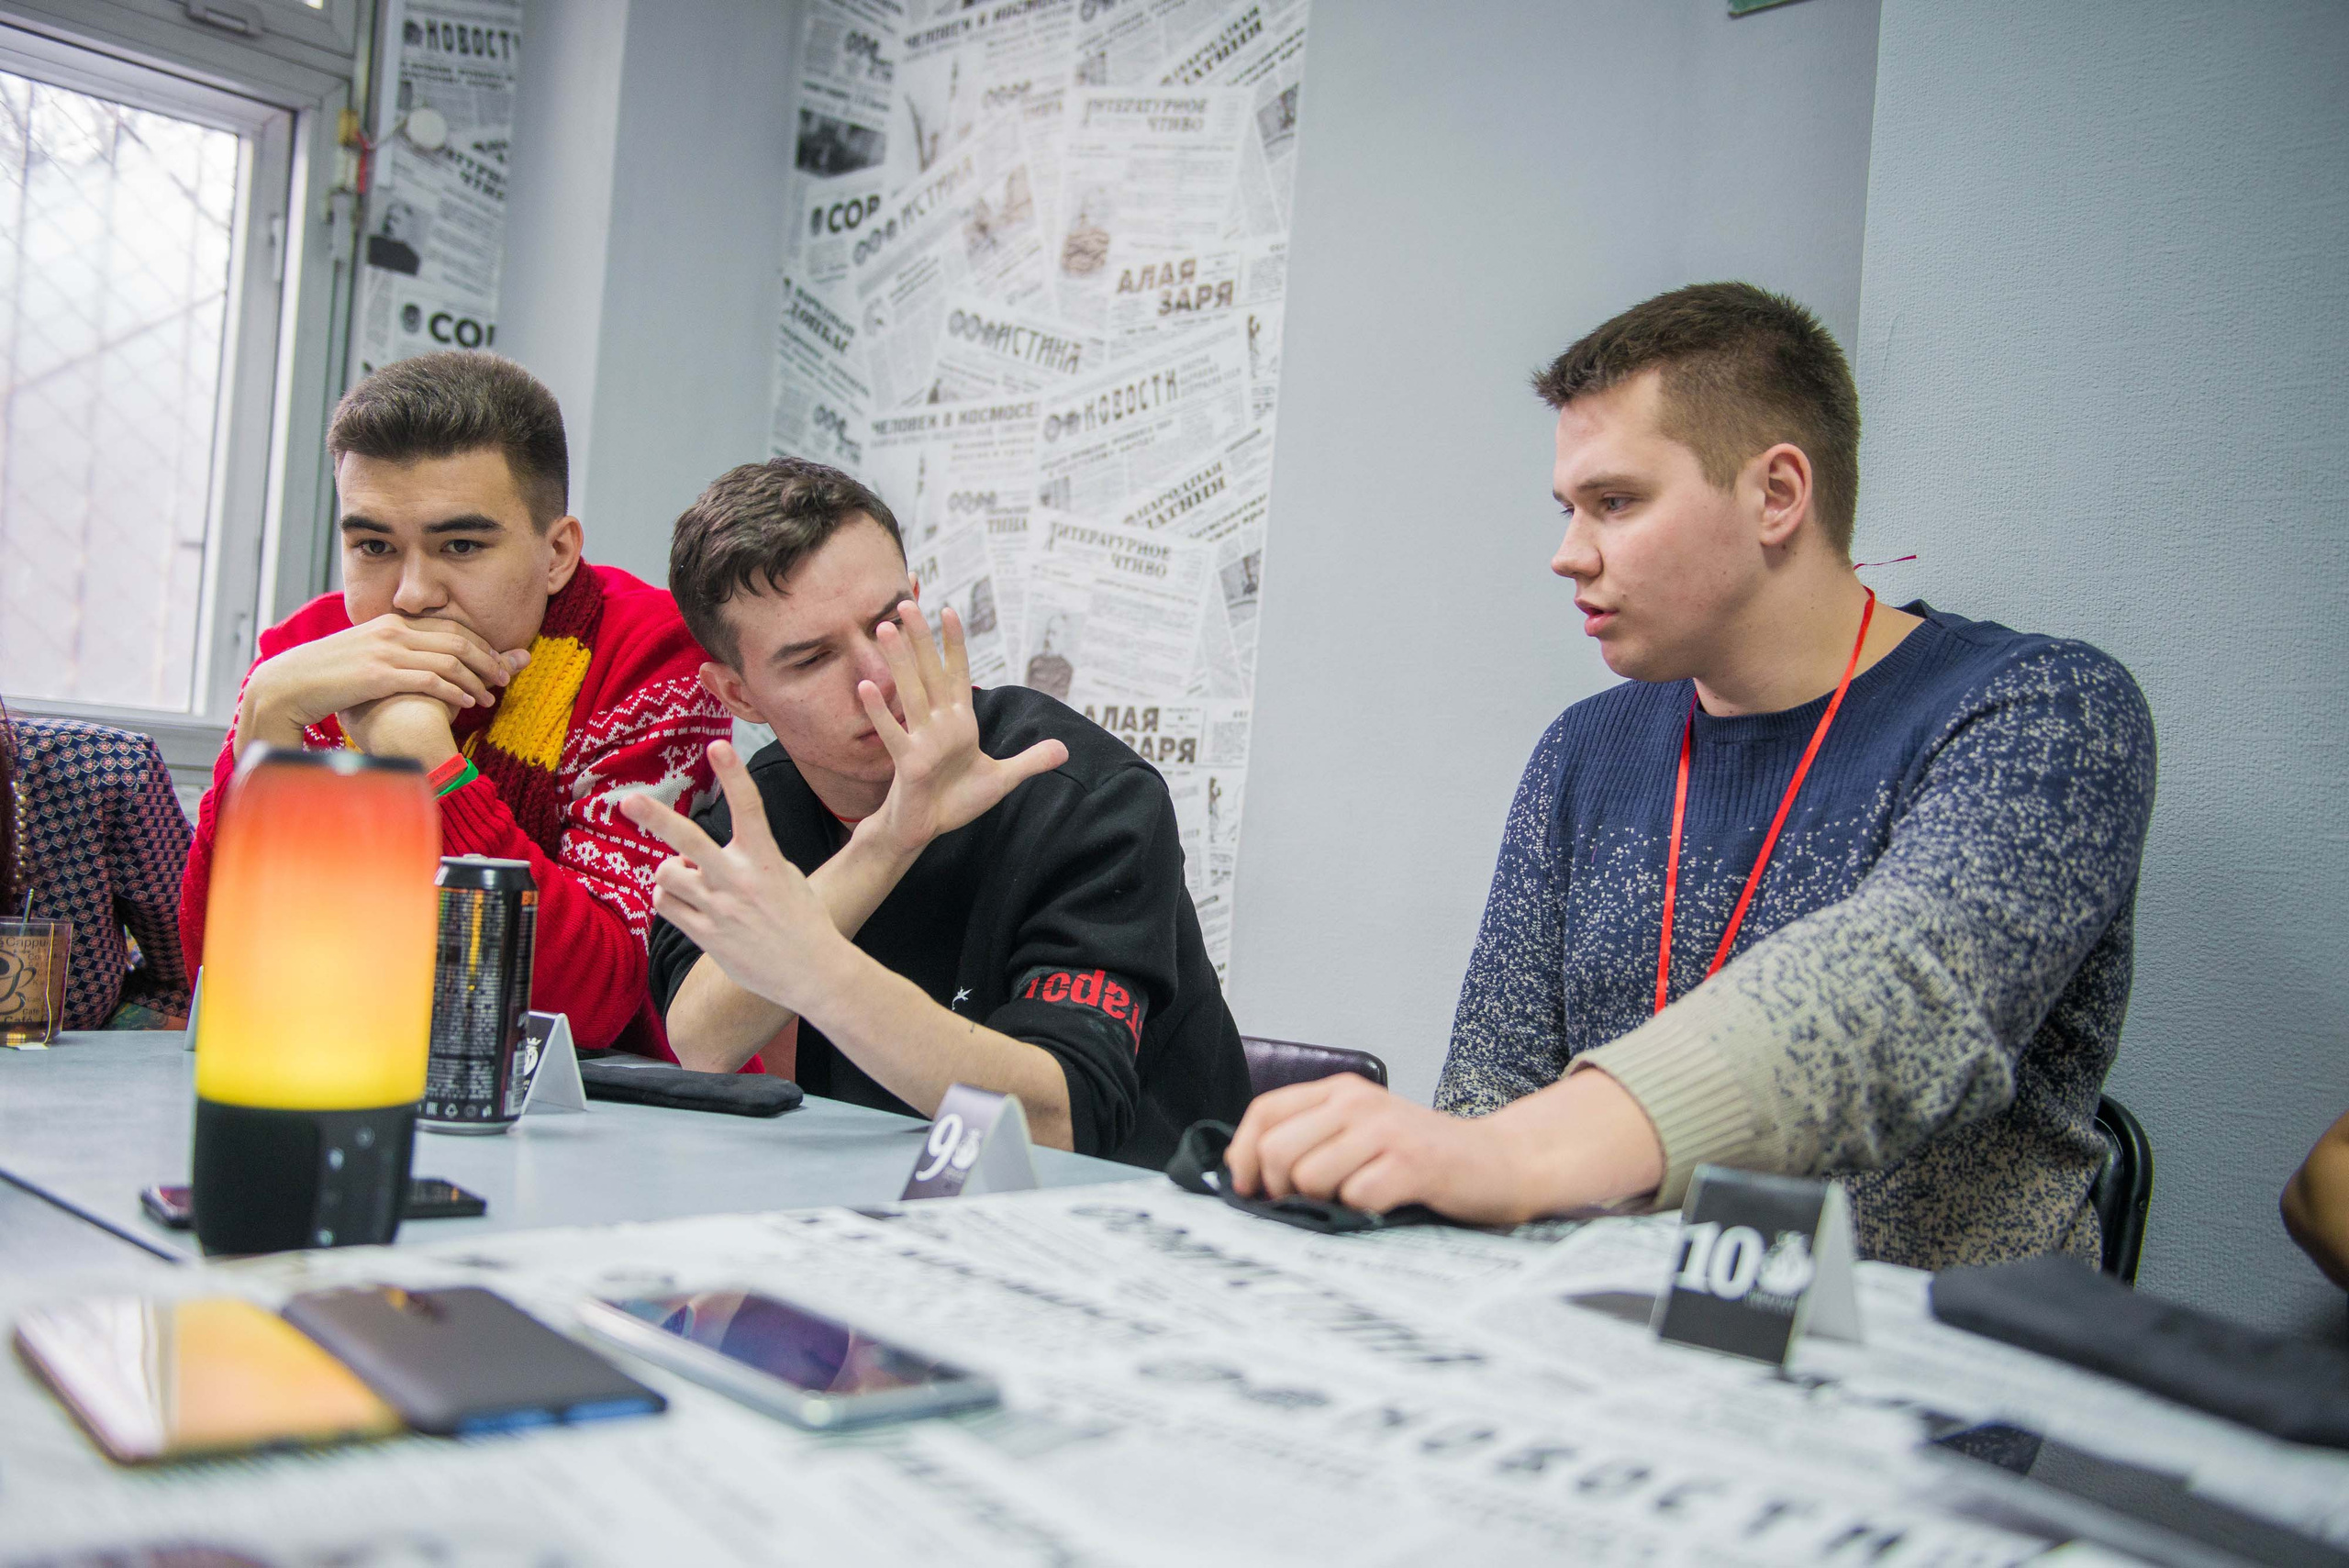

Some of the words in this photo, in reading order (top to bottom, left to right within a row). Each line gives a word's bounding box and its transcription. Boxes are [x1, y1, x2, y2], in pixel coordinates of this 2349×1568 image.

[1117, 258, 1197, 294] АЛАЯ
[1158, 280, 1234, 317] ЗАРЯ
[1084, 368, 1178, 432] НОВОСТИ
[1046, 522, 1172, 562] ЛИТЕРАТУРНОЕ
[1111, 551, 1168, 578] ЧТИВО
[915, 1113, 964, 1182] 9
[1675, 1221, 1765, 1301] 10
